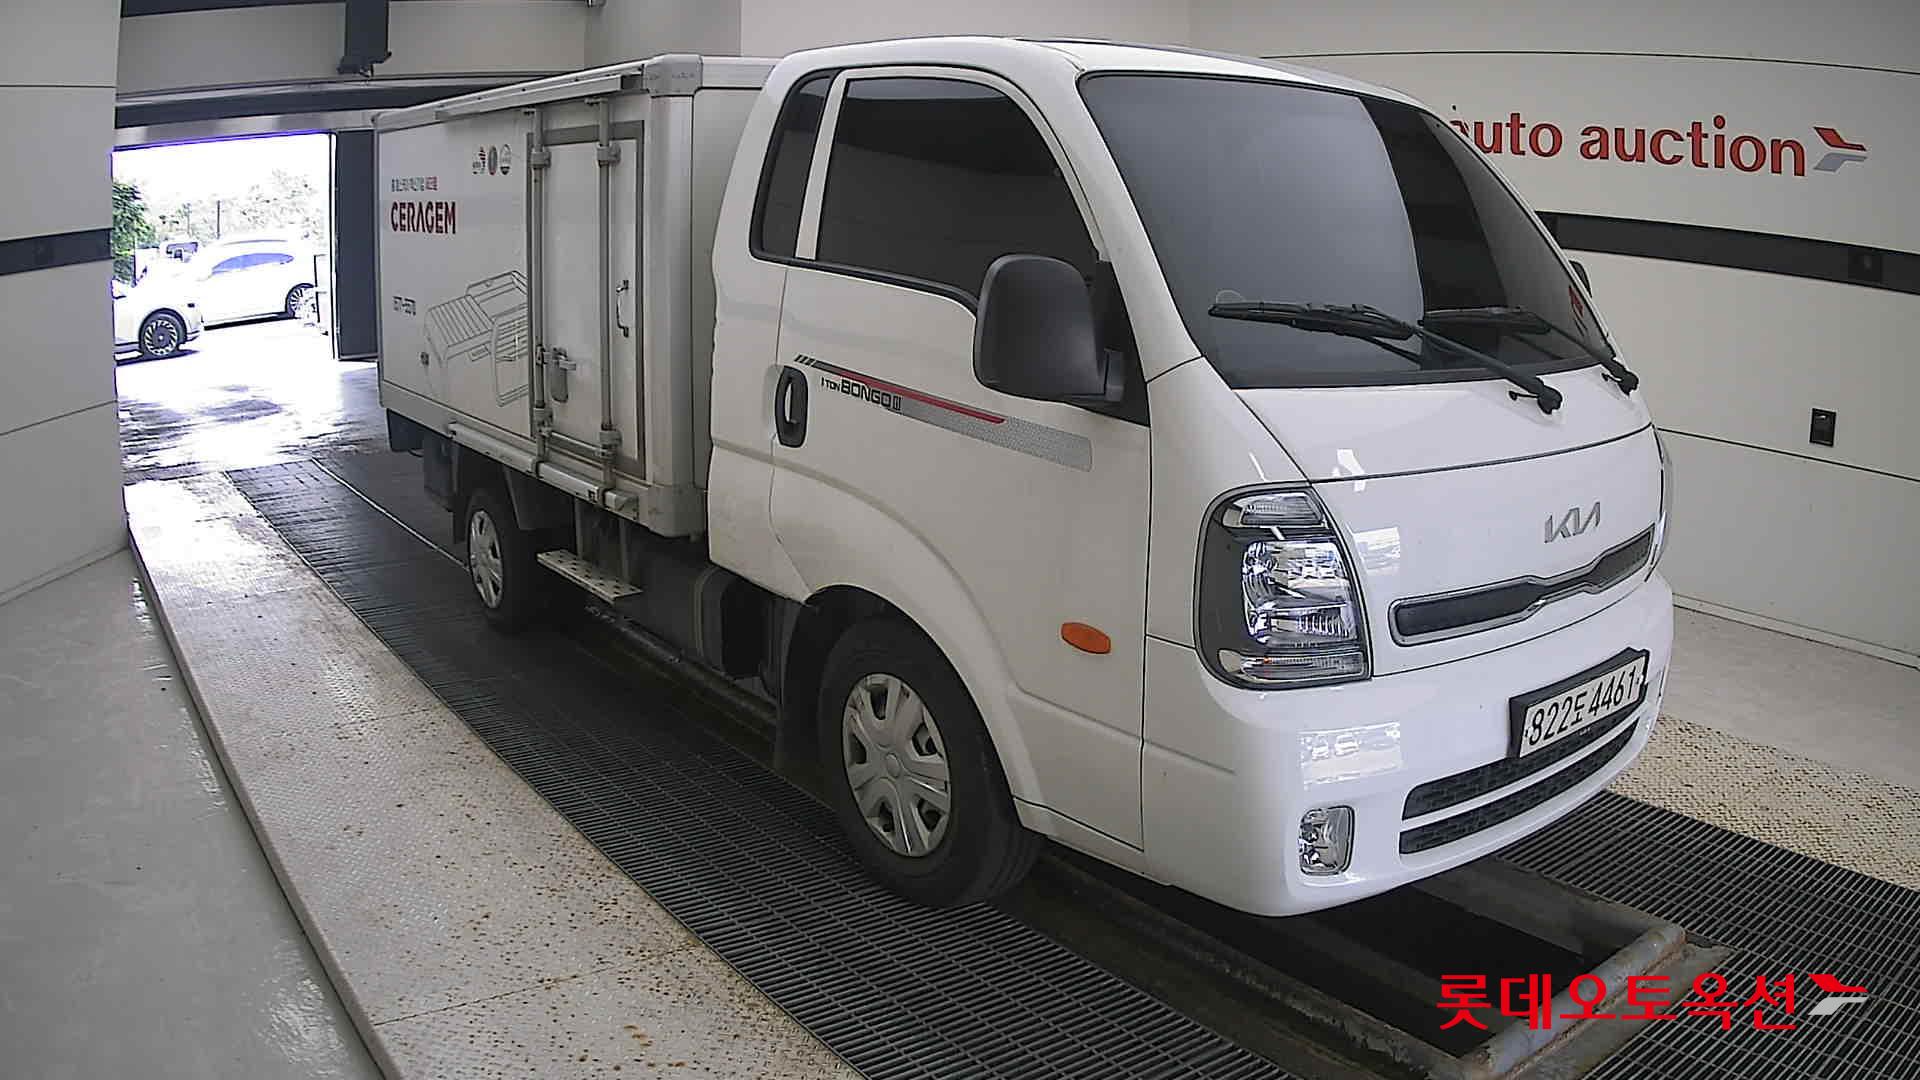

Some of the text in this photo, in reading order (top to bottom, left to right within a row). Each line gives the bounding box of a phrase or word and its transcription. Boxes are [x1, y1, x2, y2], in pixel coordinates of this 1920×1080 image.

[1580, 115, 1806, 177] auction
[390, 201, 457, 234] CERAGEM
[841, 379, 892, 408] BONGO
[1544, 501, 1601, 544] KIA
